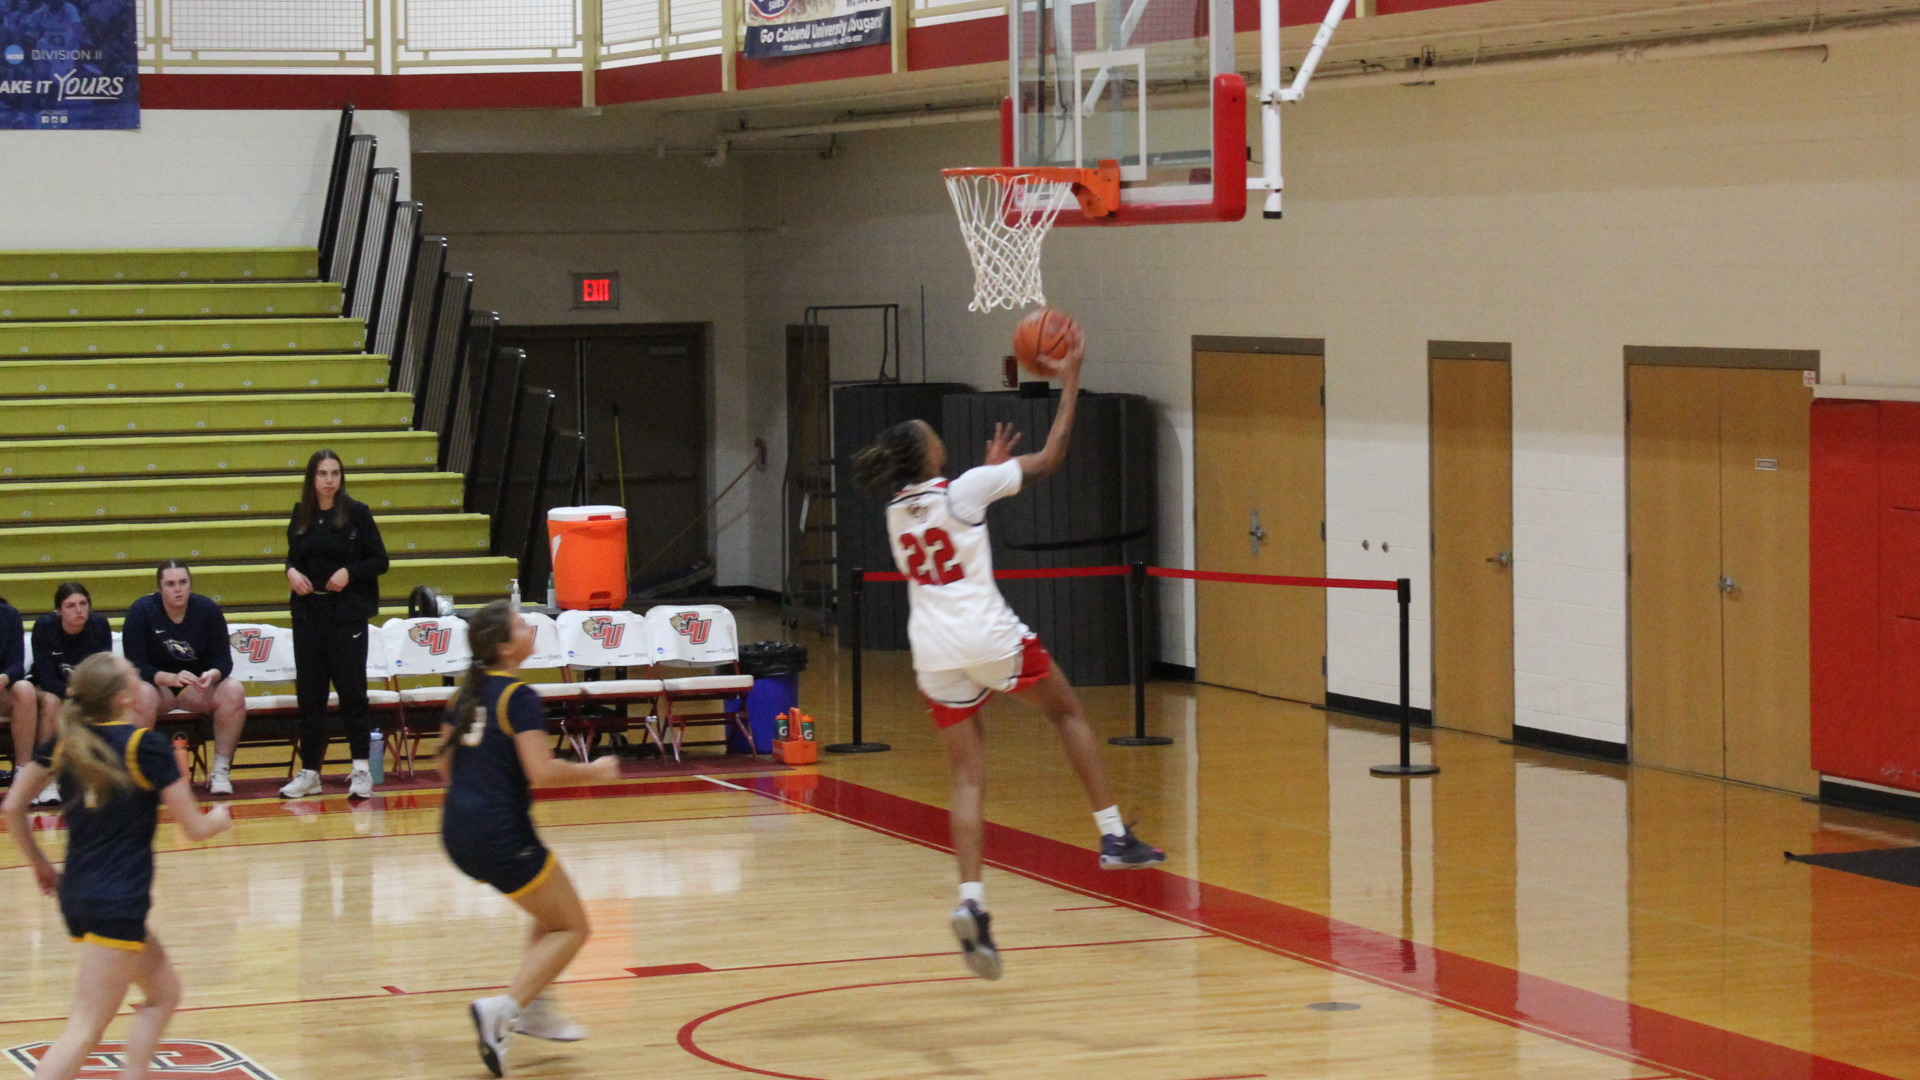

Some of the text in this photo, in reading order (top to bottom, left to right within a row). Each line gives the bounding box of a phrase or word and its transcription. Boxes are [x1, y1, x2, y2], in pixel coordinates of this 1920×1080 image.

[760, 29, 775, 43] Go
[776, 25, 810, 43] Caldwell
[812, 19, 848, 39] University
[31, 50, 103, 60] DIVISION II
[36, 81, 53, 94] IT
[54, 68, 124, 102] YOURS
[583, 279, 610, 301] EXIT
[900, 527, 966, 586] 22
[779, 726, 788, 737] G
[803, 729, 813, 740] G
